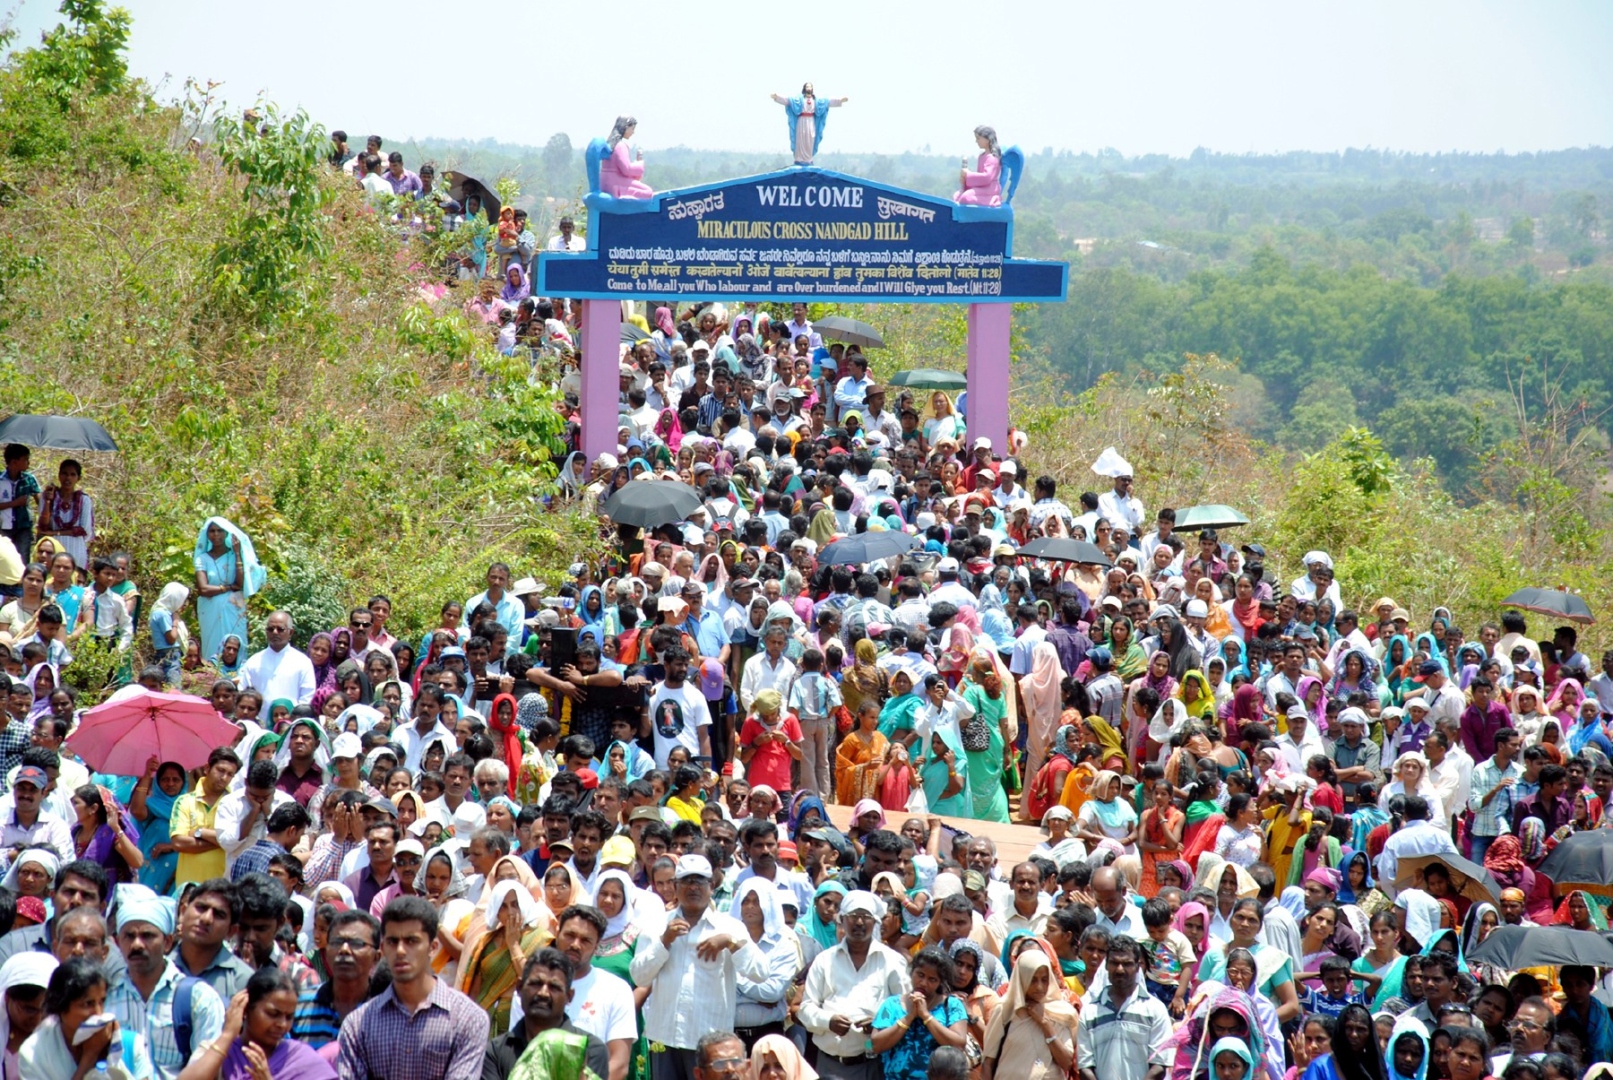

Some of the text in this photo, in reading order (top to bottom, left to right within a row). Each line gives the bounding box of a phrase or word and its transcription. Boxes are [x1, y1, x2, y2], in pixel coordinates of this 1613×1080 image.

[667, 191, 725, 220] ಸುಸ್ವಾಗತ
[757, 185, 863, 208] WELCOME
[877, 196, 936, 223] सुस्वागत
[697, 220, 908, 241] MIRACULOUS CROSS NANDGAD HILL
[608, 246, 635, 260] ದುಡಿದು
[739, 248, 758, 262] ಸರ್ವ
[816, 248, 831, 266] ನನ್ನ
[630, 261, 649, 279] तुमी
[855, 267, 886, 282] तुमका
[607, 278, 633, 290] Come
[635, 279, 647, 290] to
[678, 282, 695, 294] you
[695, 280, 717, 291] Who
[718, 280, 751, 292] labour
[752, 281, 772, 293] and
[777, 283, 794, 293] are
[794, 281, 815, 293] Over
[815, 281, 861, 293] burdened
[861, 281, 879, 293] and
[884, 281, 904, 293] Will
[926, 284, 945, 296] you
